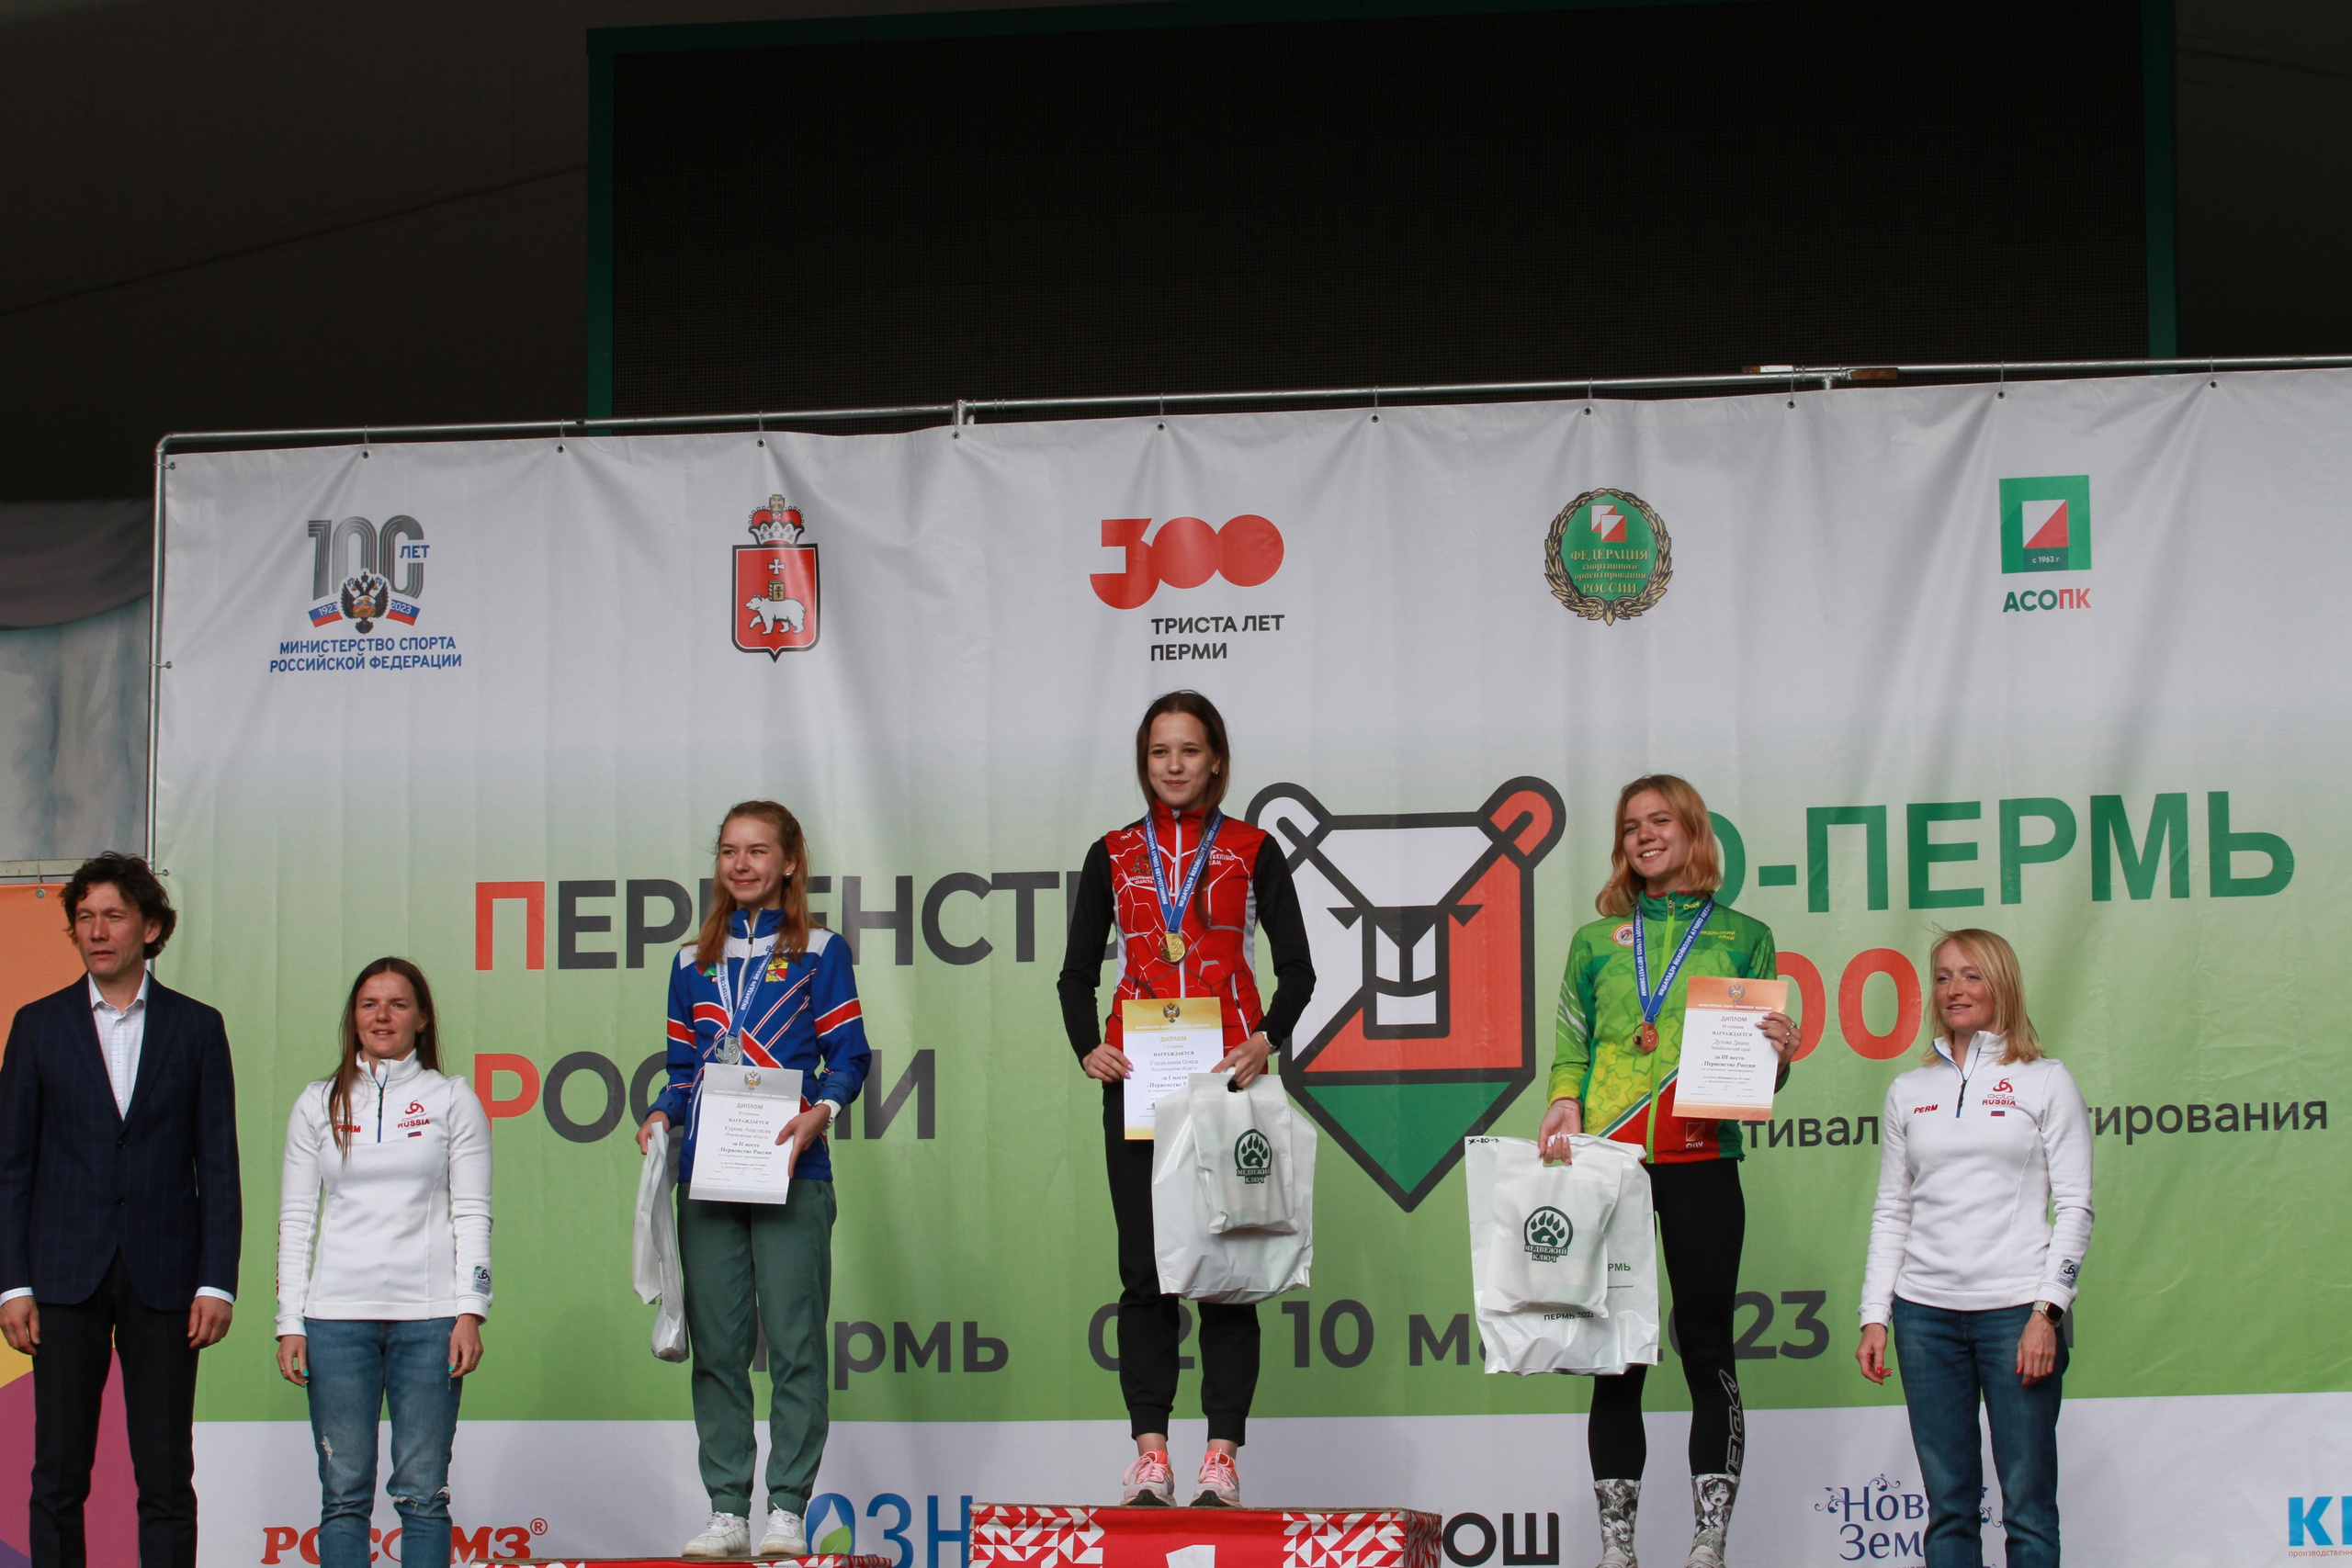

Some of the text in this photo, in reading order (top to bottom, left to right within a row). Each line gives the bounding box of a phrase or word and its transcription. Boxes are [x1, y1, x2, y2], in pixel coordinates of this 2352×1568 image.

[307, 514, 424, 601] 100
[400, 545, 430, 558] ЛЕТ
[1571, 549, 1648, 561] ФЕДЕРАЦИЯ
[1090, 514, 1284, 610] 300
[1582, 563, 1638, 572] спортивного
[1575, 572, 1646, 582] ориентирования
[1583, 583, 1637, 594] РОССИИ
[2003, 588, 2092, 613] АСОПК
[318, 602, 338, 615] 1923
[390, 602, 412, 615] 2023
[1151, 615, 1284, 635] ТРИСТА ЛЕТ
[279, 637, 456, 655] МИНИСТЕРСТВО СПОРТА
[1151, 643, 1227, 661] ПЕРМИ
[269, 653, 462, 673] РОССИЙСКОЙ ФЕДЕРАЦИИ
[1914, 1104, 1939, 1114] PERM
[397, 1118, 430, 1129] RUSSIA
[724, 1125, 743, 1134] Курова
[1742, 1100, 2327, 1148] тивал ирования
[1524, 1245, 1567, 1256] МЕДВЕЖИЙ
[1532, 1254, 1557, 1262] КЛЮЧ
[1608, 1263, 1631, 1272] РМЬ
[1544, 1313, 1576, 1321] ПЕРМЬ
[1282, 1299, 1374, 1369] 10
[1839, 1486, 1929, 1522] Нов
